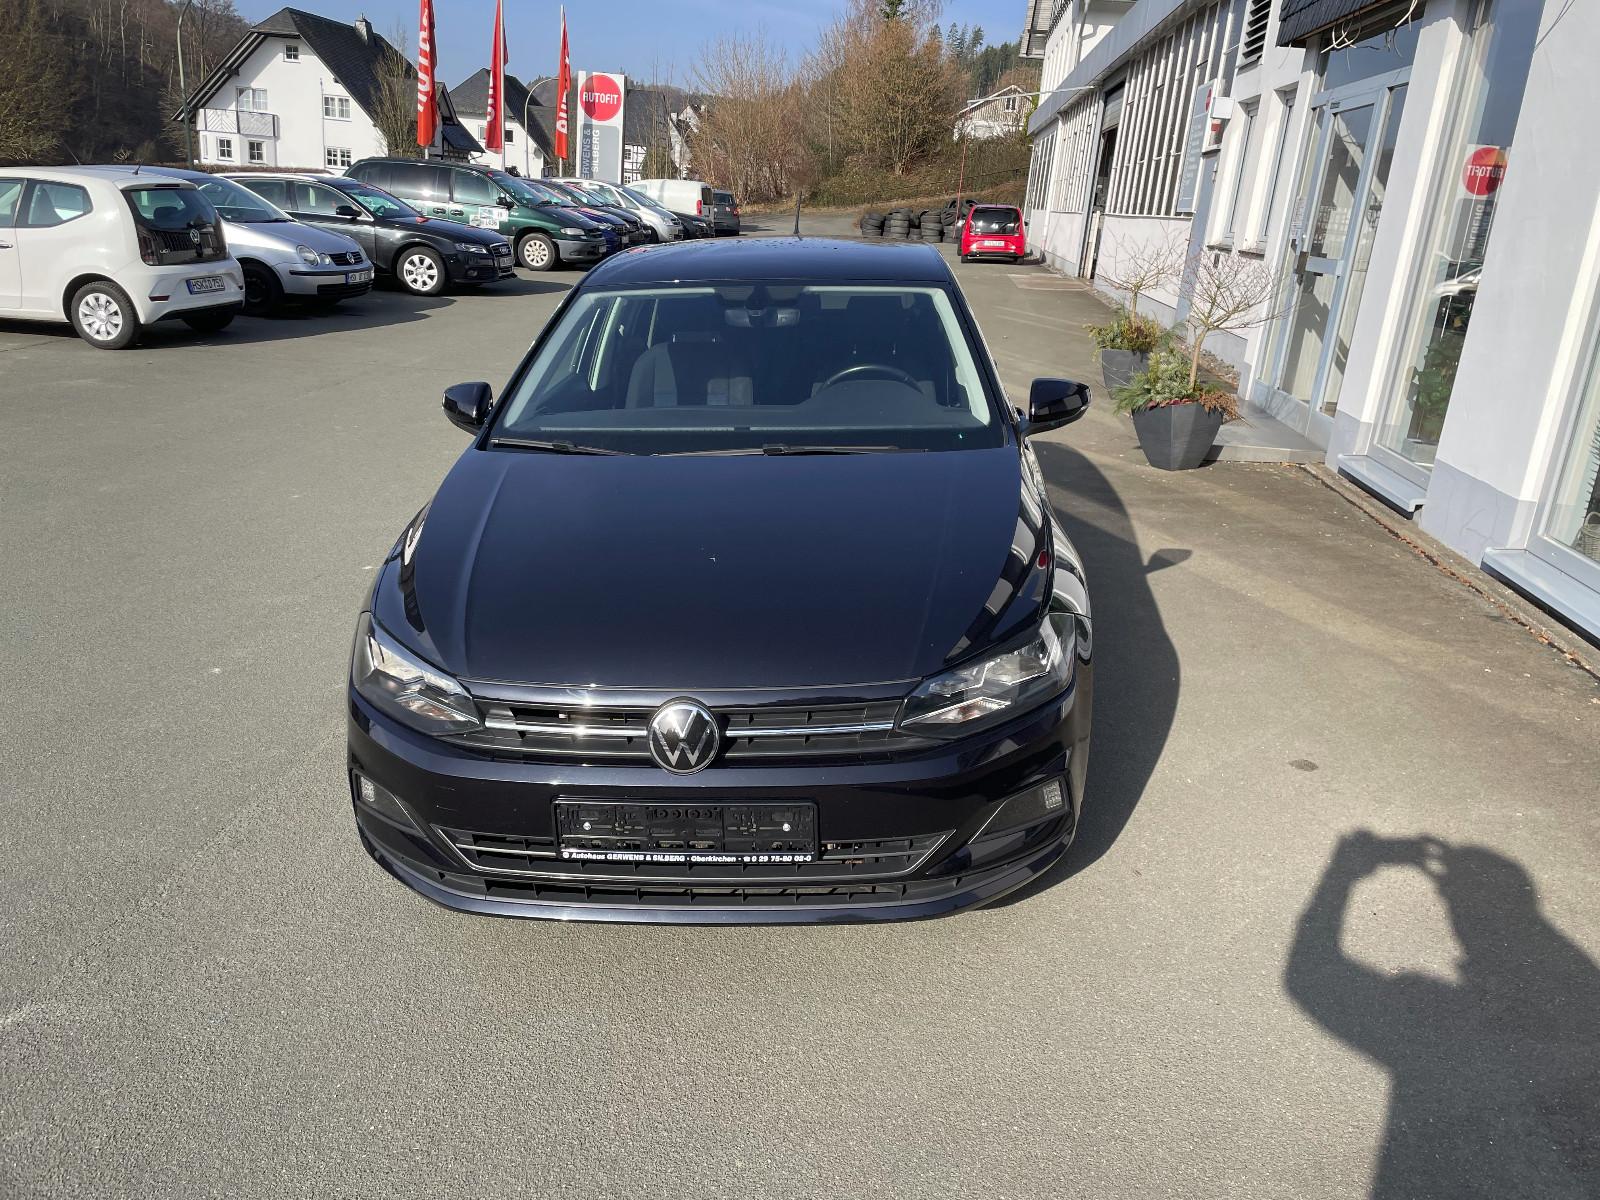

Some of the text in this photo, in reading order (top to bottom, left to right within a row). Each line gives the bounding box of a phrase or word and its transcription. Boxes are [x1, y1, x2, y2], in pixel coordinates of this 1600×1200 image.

[583, 91, 619, 105] AUTOFIT
[591, 129, 600, 173] SILBERG
[571, 852, 605, 860] Autohaus
[606, 853, 644, 861] GERWENS
